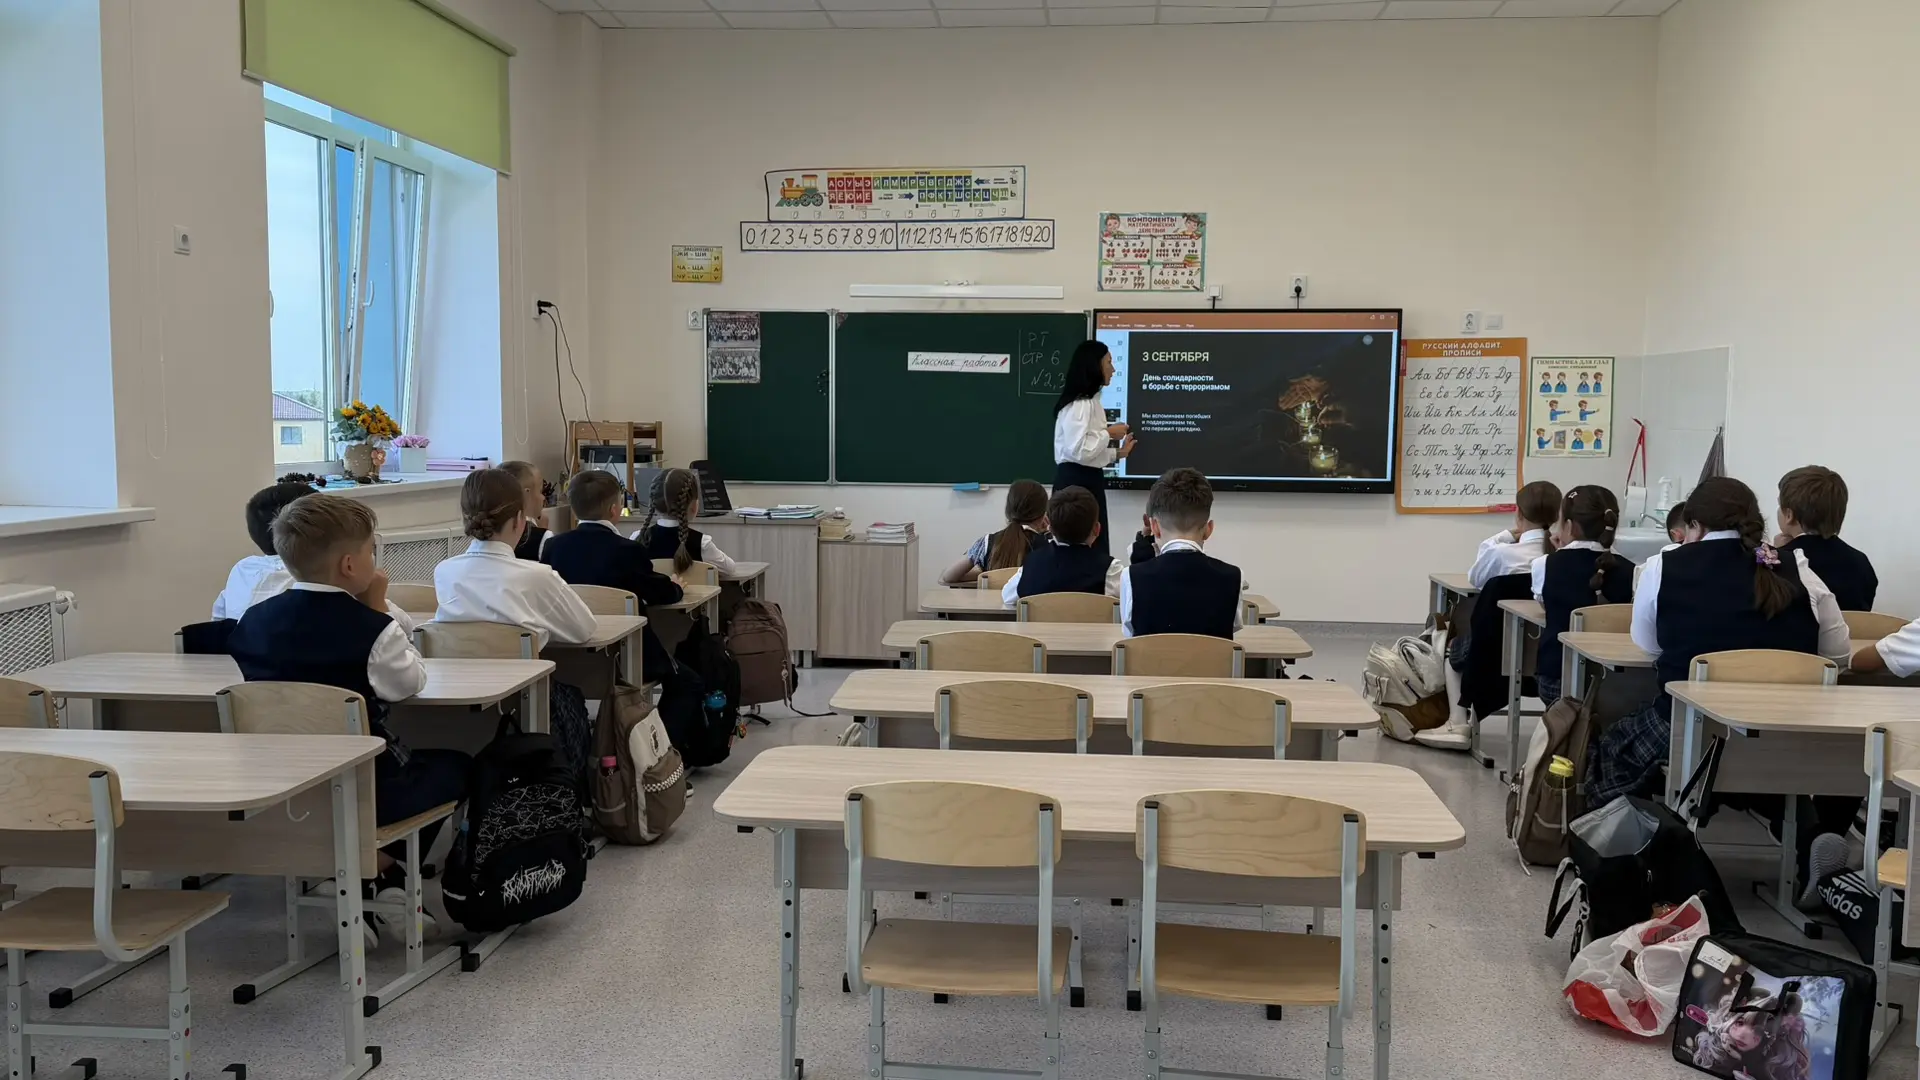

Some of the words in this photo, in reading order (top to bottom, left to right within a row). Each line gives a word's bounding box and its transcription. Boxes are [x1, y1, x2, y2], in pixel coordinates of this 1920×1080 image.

[746, 228, 756, 245] 0
[760, 228, 767, 245] 1
[770, 228, 780, 245] 2
[785, 228, 794, 245] 3
[798, 228, 808, 245] 4
[813, 228, 824, 245] 5
[827, 228, 838, 245] 6
[840, 228, 850, 245] 7
[853, 228, 863, 245] 8
[866, 228, 877, 245] 9
[879, 228, 894, 244] 10
[900, 227, 912, 244] 11
[912, 228, 927, 244] 12
[928, 227, 942, 244] 13
[944, 227, 957, 244] 14
[959, 227, 973, 244] 15
[975, 227, 989, 243] 16
[989, 226, 1004, 243] 17
[1005, 226, 1019, 243] 18
[1019, 226, 1034, 243] 19
[1033, 226, 1051, 243] 20
[960, 355, 998, 371] работа
[1051, 349, 1060, 366] 6
[1142, 351, 1149, 362] 3
[1151, 351, 1209, 362] СЕНТЯБРЯ
[1142, 373, 1161, 382] День
[1162, 374, 1214, 383] солидарности
[1148, 382, 1174, 391] борьбе
[1181, 383, 1231, 392] терроризмом
